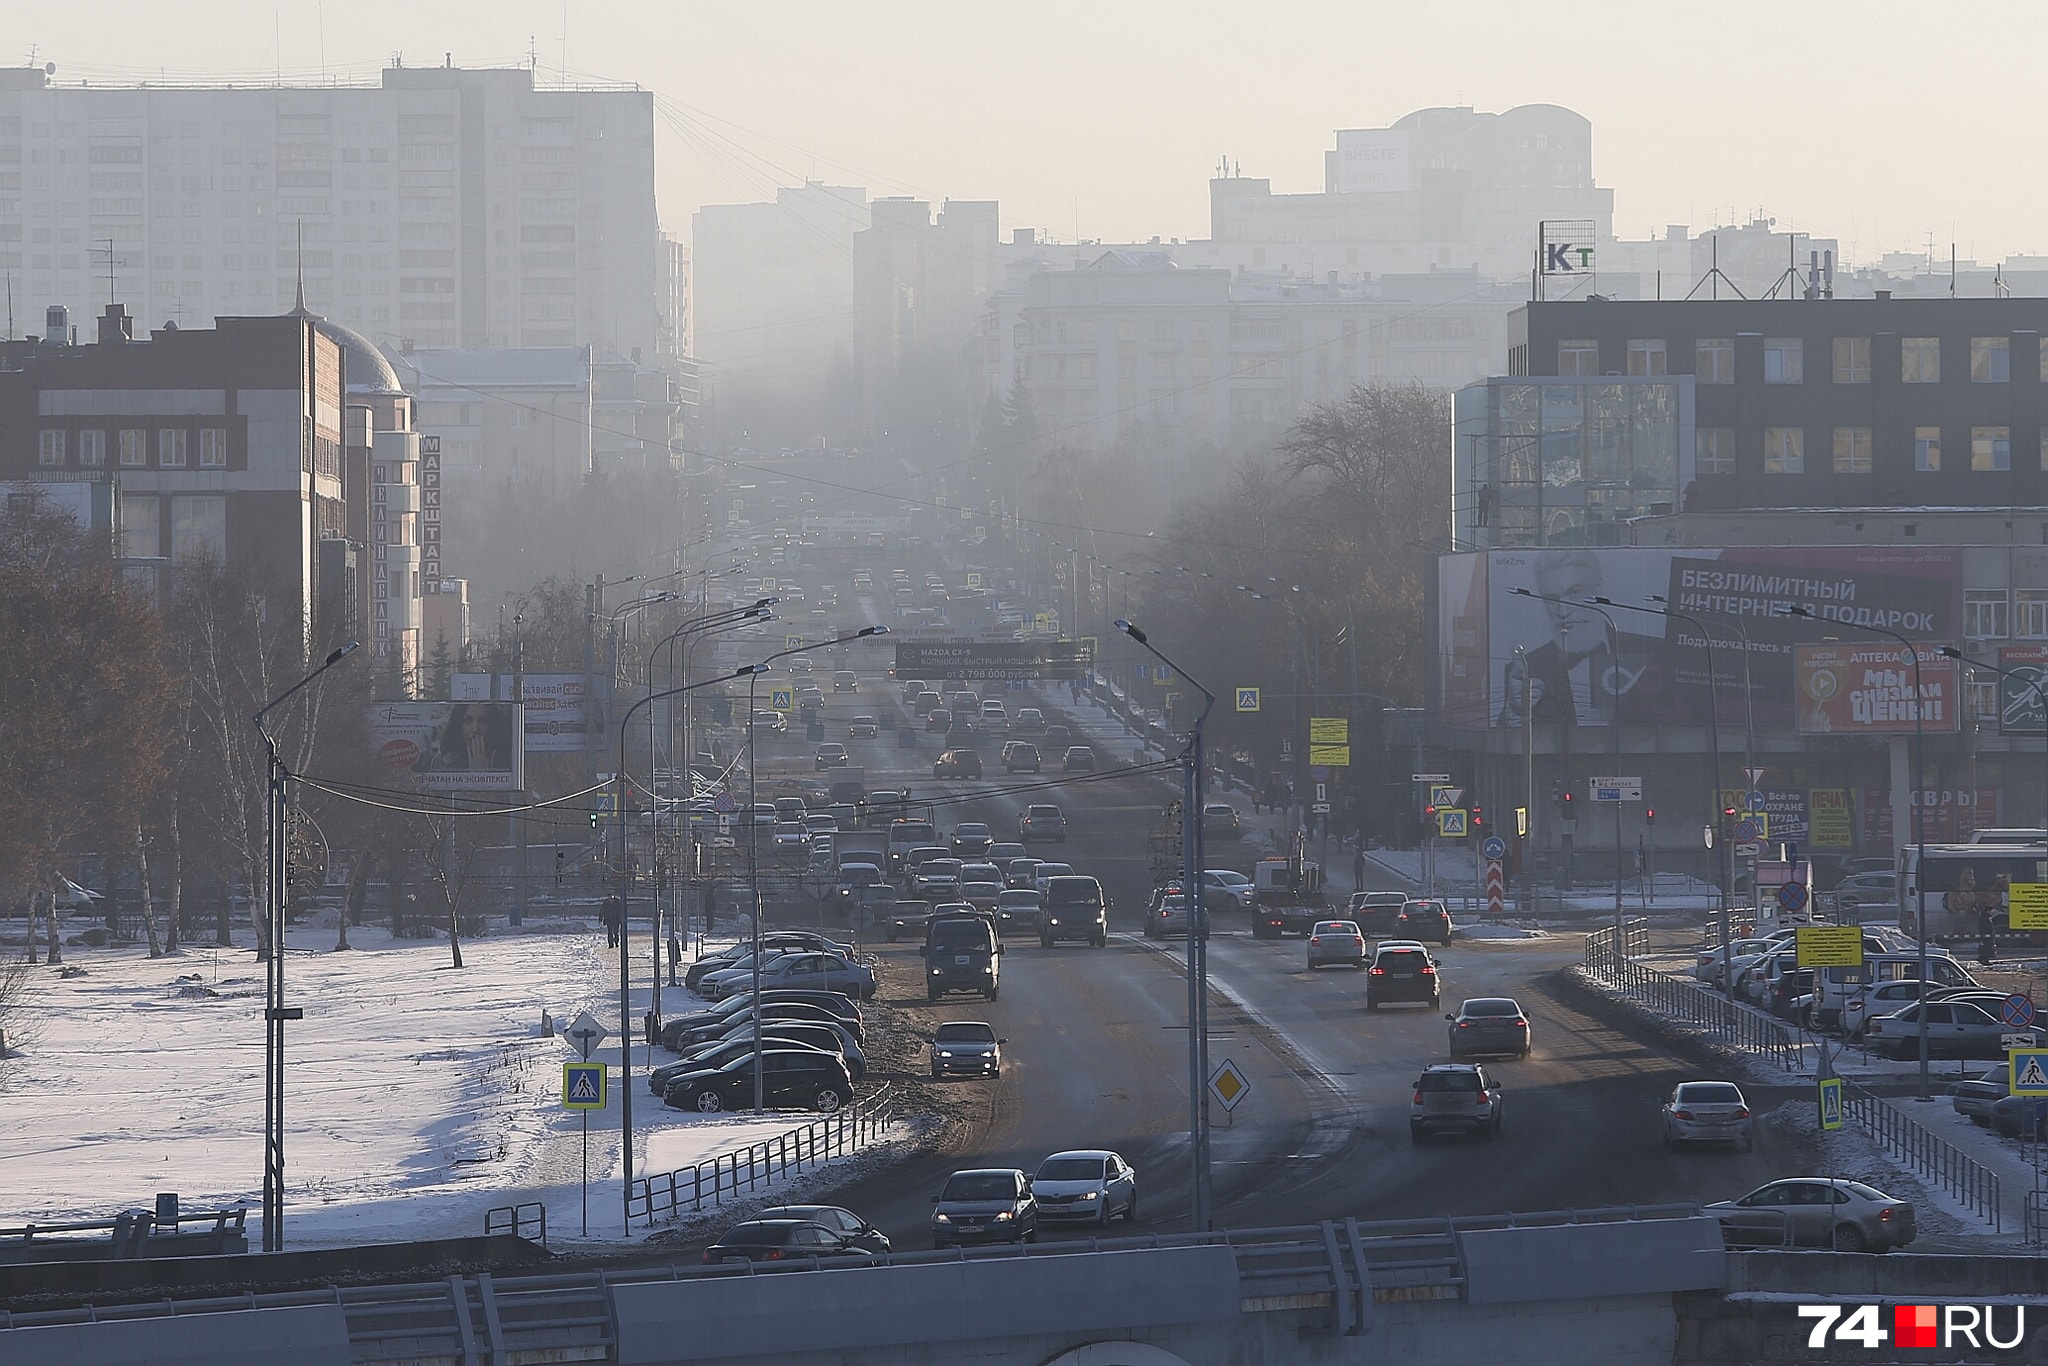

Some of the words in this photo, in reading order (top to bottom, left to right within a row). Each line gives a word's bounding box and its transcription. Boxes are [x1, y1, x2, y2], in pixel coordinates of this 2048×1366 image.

[425, 437, 440, 594] МАРКШТАДТ
[375, 466, 387, 656] ЧЕЛИНДБАНК
[1681, 569, 1855, 601] БЕЗЛИМИТНЫЙ
[1679, 592, 1796, 618] ИНТЕРНЕТ
[1822, 604, 1935, 632] ПОДАРОК
[921, 648, 950, 656] MAZDA
[1678, 634, 1779, 654] Подключайтесь
[1850, 651, 1900, 664] АПТЕКА
[1919, 650, 1950, 662] ВИТА
[959, 670, 965, 678] 2
[968, 670, 985, 678] 798
[988, 670, 1006, 678] 000
[1008, 670, 1039, 679] рублей
[1864, 669, 1906, 688] МЫ
[1850, 683, 1942, 704] СНИЗИЛИ
[1852, 700, 1942, 724] ЦЕНЫ!
[452, 775, 463, 783] НА
[464, 775, 510, 783] ЭКОФЛЕКСЕ
[1768, 792, 1787, 800] Всё
[1788, 793, 1800, 801] по
[1812, 791, 1849, 808] ПЕЧАТ
[1765, 803, 1804, 811] ОХРАНЕ
[1769, 814, 1800, 823] ТРУДА
